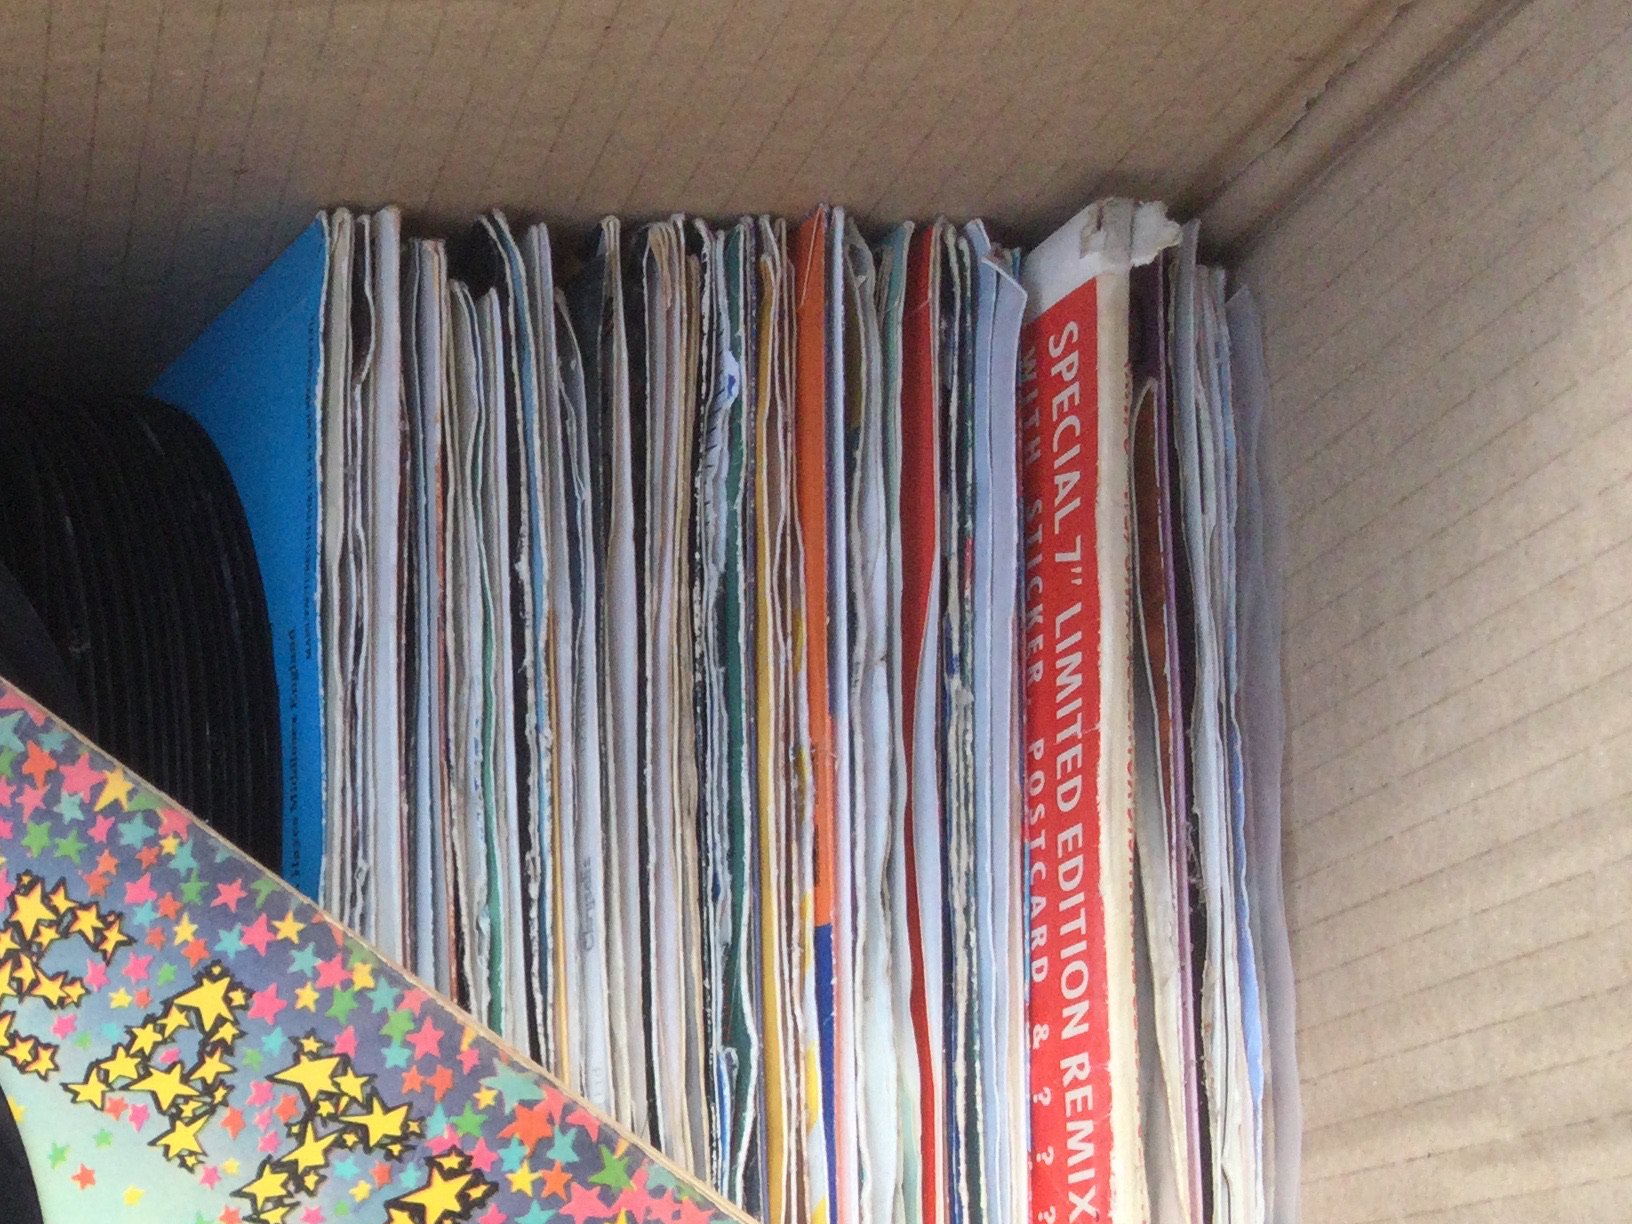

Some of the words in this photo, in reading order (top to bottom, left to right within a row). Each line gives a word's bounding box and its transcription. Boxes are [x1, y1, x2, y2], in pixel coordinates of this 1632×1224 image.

[1020, 345, 1042, 464] WITH
[1048, 321, 1081, 535] SPECIAL
[1028, 500, 1045, 684] STICKER
[1054, 535, 1082, 587] 7"
[287, 628, 299, 708] England
[1055, 602, 1084, 813] LIMITED
[1027, 738, 1050, 983] POSTCARD
[1057, 823, 1089, 1042] EDITION
[1032, 1023, 1052, 1050] &
[1060, 1051, 1098, 1224] REMIX
